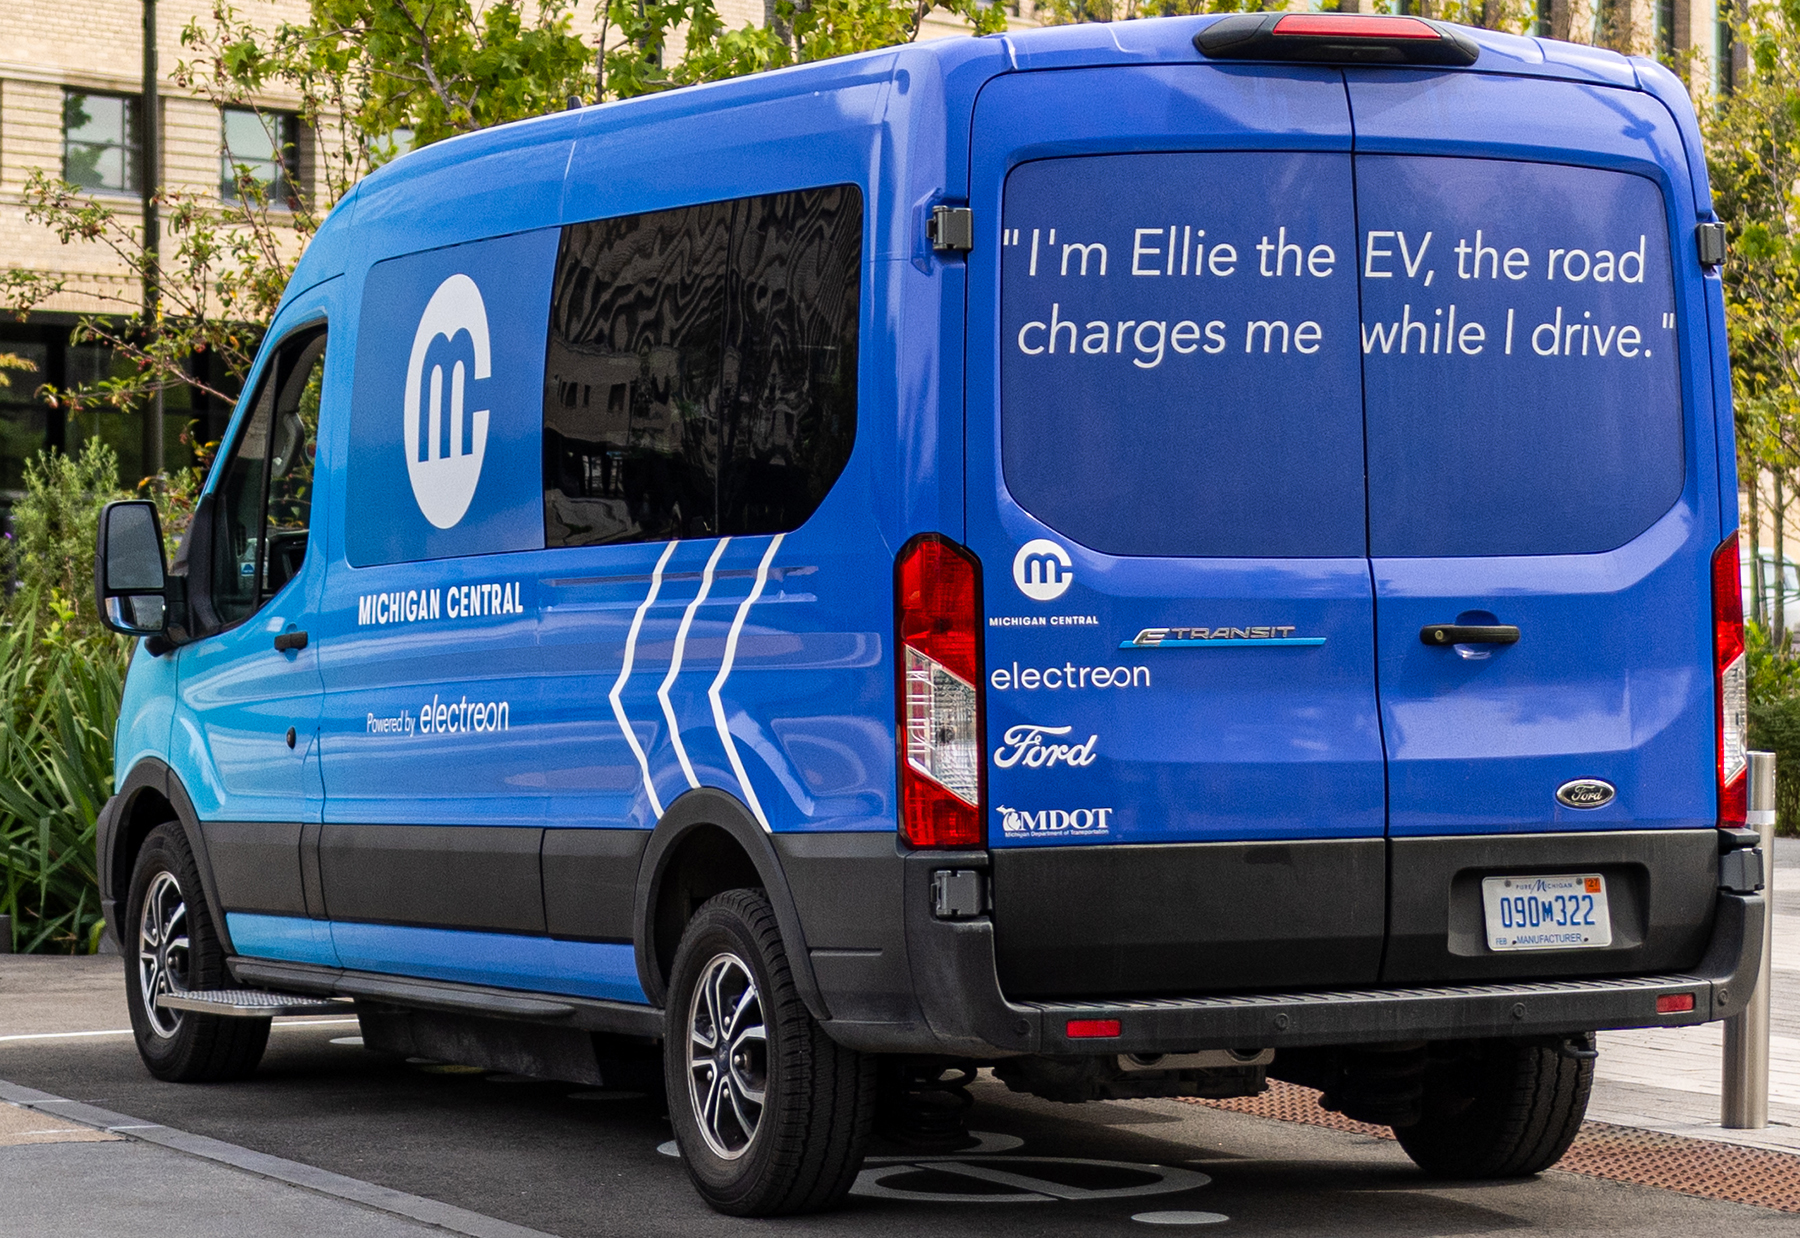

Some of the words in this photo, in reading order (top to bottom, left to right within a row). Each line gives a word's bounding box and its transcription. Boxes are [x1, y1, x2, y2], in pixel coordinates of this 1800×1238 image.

[1130, 226, 1238, 276] Ellie
[1256, 227, 1336, 277] the
[1364, 231, 1434, 287] EV,
[1454, 230, 1531, 282] the
[1547, 234, 1645, 284] road
[1017, 303, 1226, 368] charges
[1245, 317, 1323, 354] me
[1362, 304, 1486, 355] while
[1504, 309, 1514, 355] I
[358, 588, 441, 626] MICHIGAN
[446, 581, 524, 619] CENTRAL
[989, 616, 1047, 627] MICHIGAN
[1050, 615, 1100, 626] CENTRAL
[1171, 626, 1296, 640] TRANSIT
[990, 661, 1151, 690] electreon
[366, 709, 402, 734] Powered
[404, 709, 416, 737] by
[420, 693, 509, 734] electreon
[993, 724, 1098, 768] Ford
[1571, 784, 1604, 801] Ford
[1018, 807, 1112, 831] MDOT
[1495, 937, 1507, 945] FEB
[1516, 932, 1582, 944] MANUFACTURER
